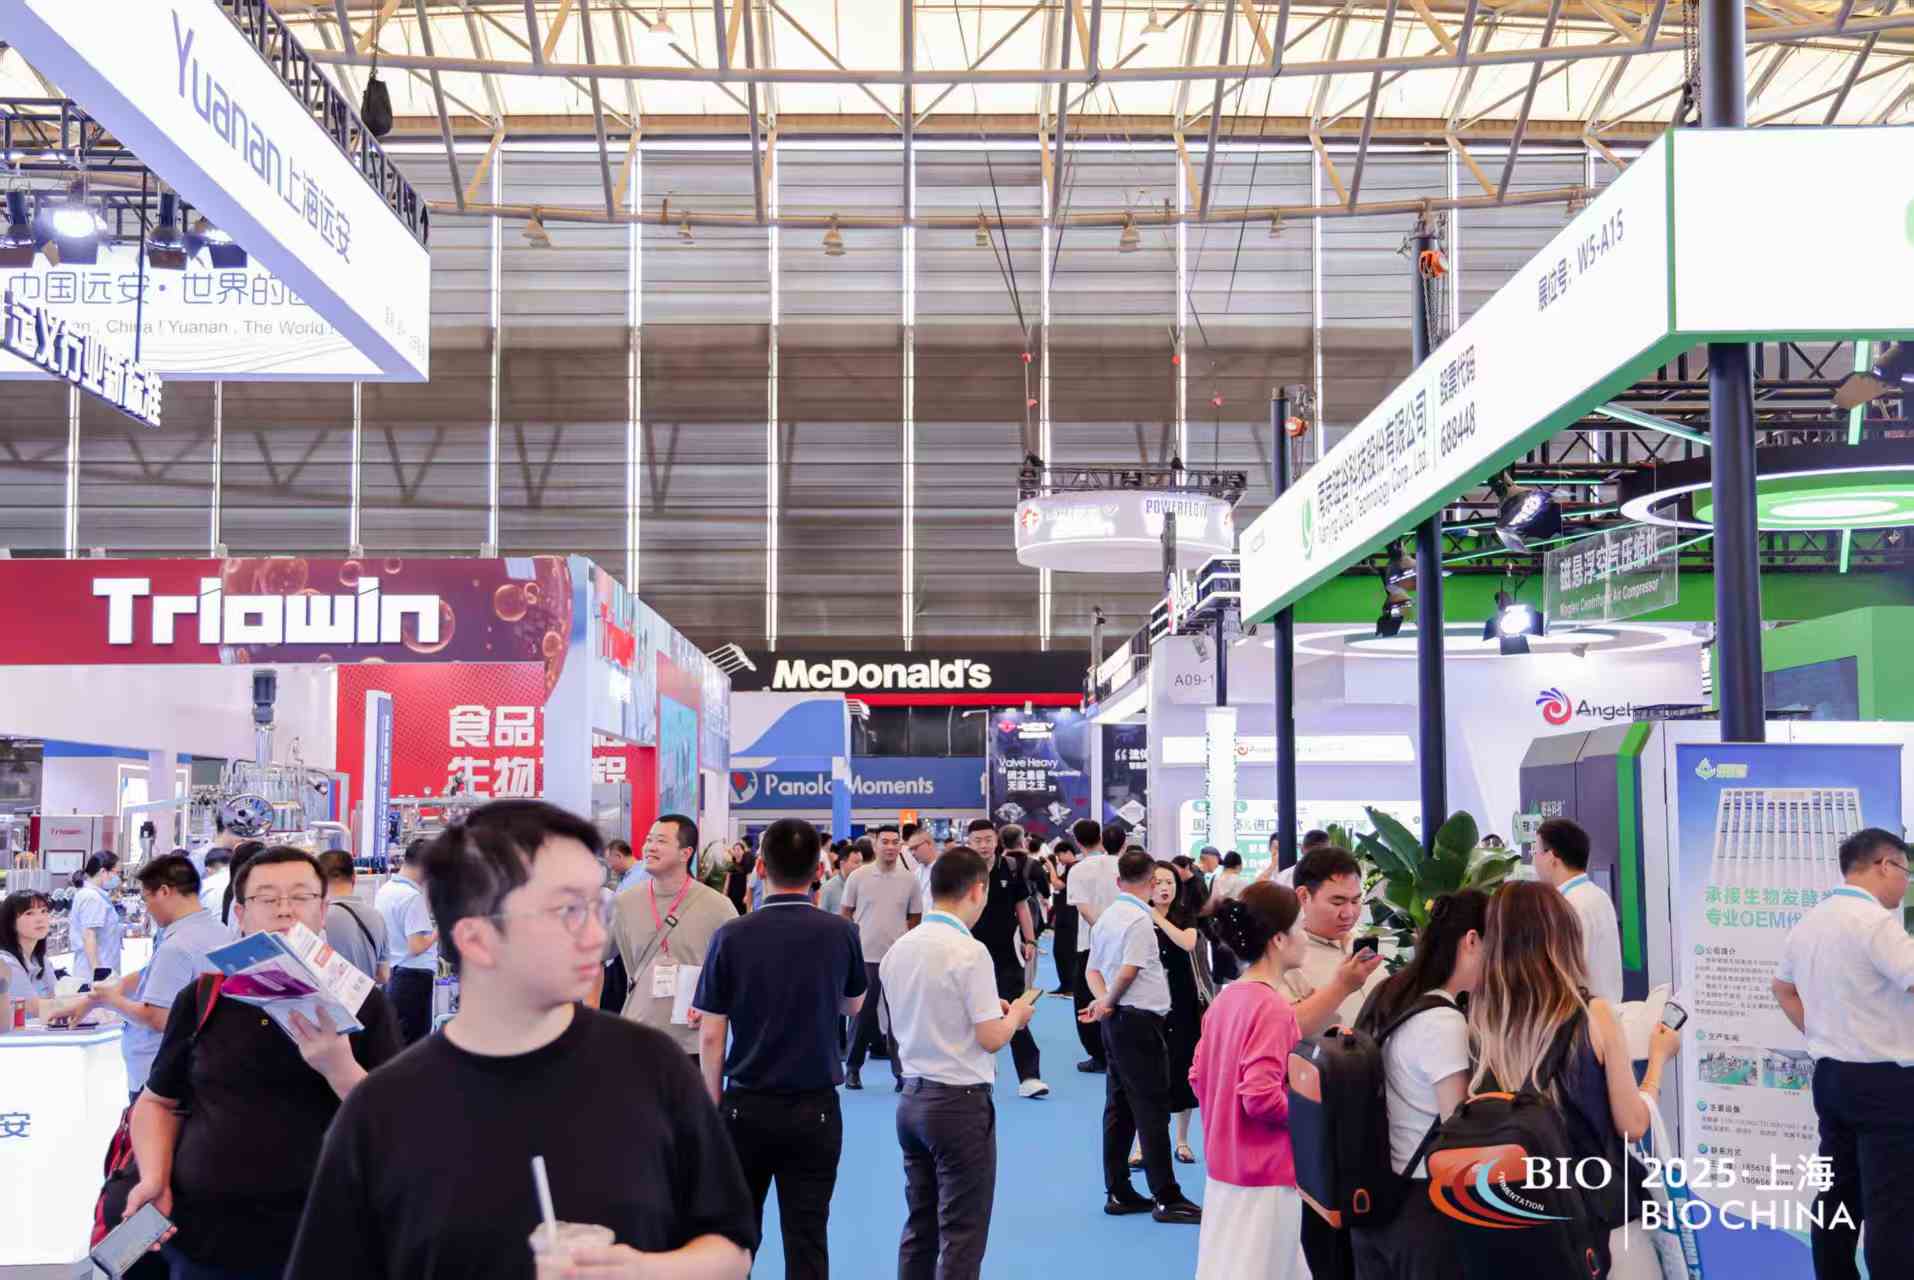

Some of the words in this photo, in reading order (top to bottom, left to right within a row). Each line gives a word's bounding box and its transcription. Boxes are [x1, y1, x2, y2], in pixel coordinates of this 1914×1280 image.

[171, 8, 282, 197] Yuanan
[283, 156, 351, 264] 上海远安
[1577, 208, 1625, 275] W5-A15
[9, 272, 308, 305] 中国远安·世界的
[1441, 402, 1475, 457] 688448
[92, 577, 440, 645] Triowin
[772, 659, 992, 689] McDonald's
[1705, 886, 1831, 908] 承接生物发酵
